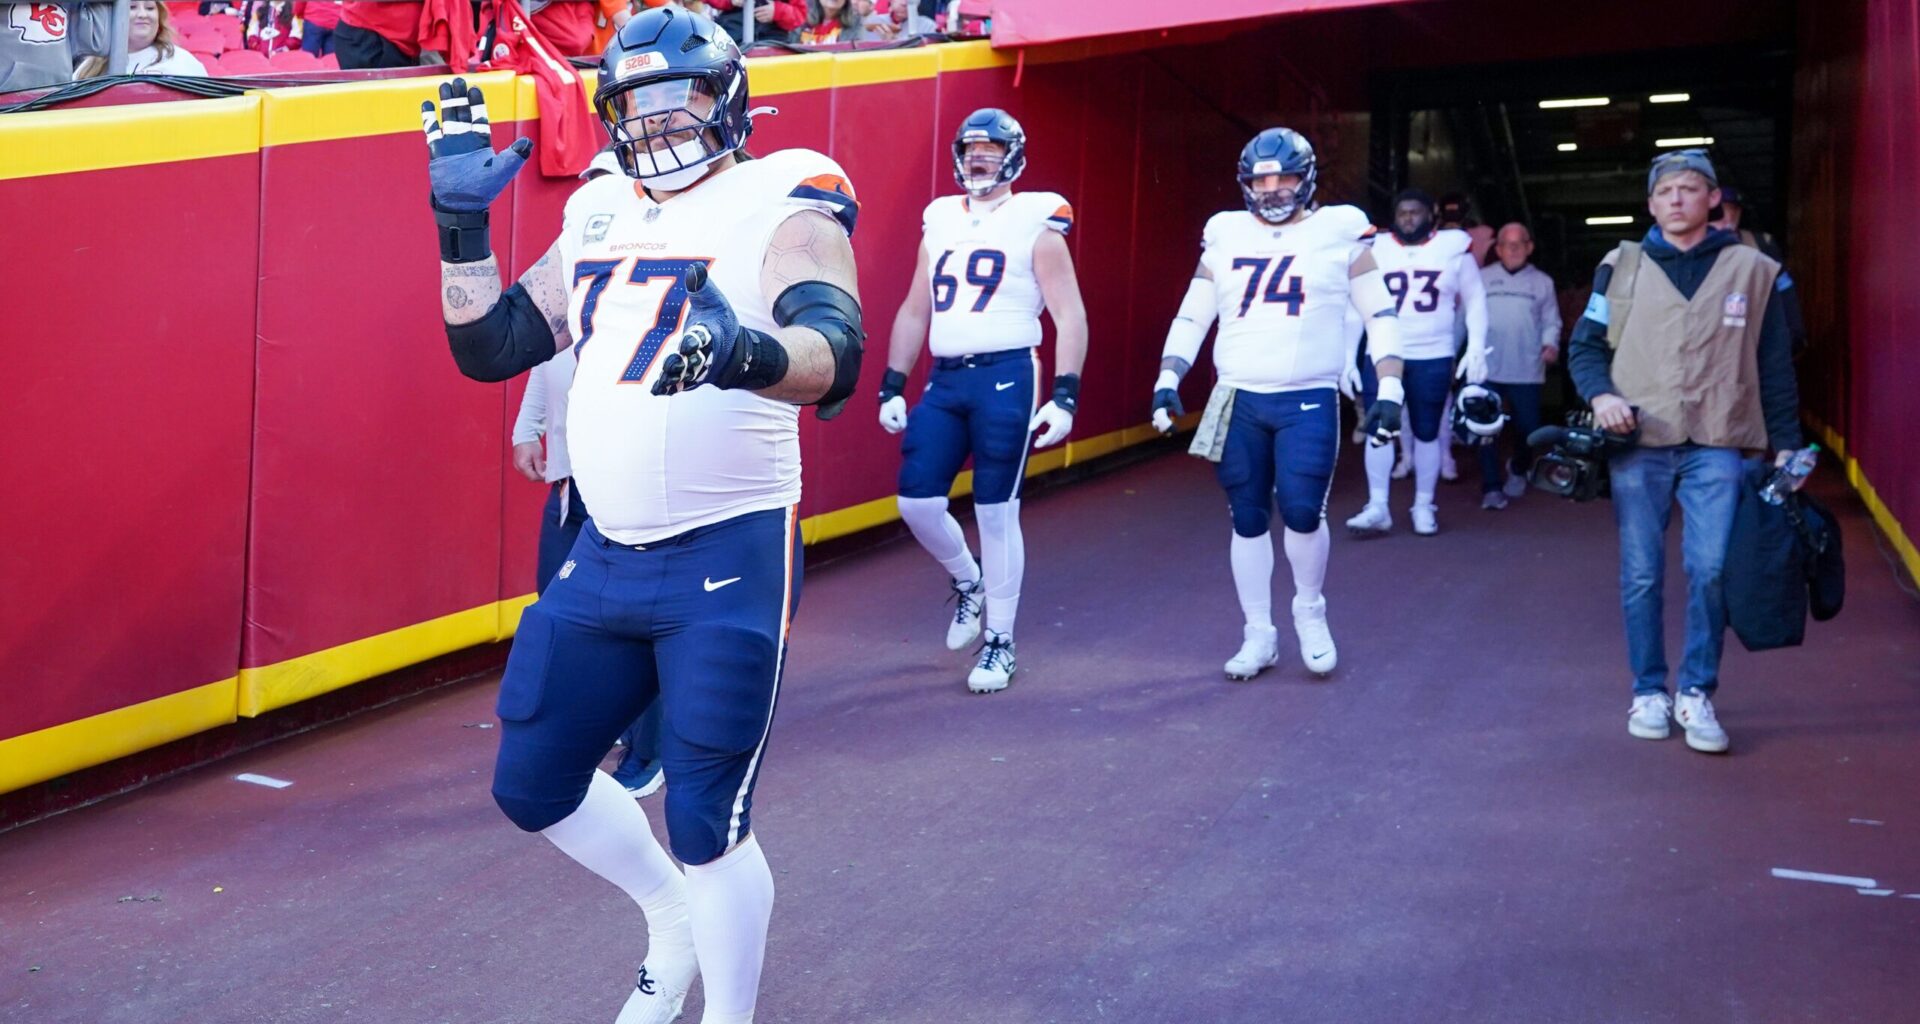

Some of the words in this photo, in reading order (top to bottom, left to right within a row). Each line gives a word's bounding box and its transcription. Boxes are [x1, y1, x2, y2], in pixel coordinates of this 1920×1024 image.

[30, 3, 65, 37] KC
[625, 54, 651, 70] 5280
[609, 243, 668, 252] BRONCOS
[932, 249, 1006, 313] 69
[1231, 255, 1305, 317] 74
[1383, 270, 1442, 314] 93
[573, 256, 716, 385] 77
